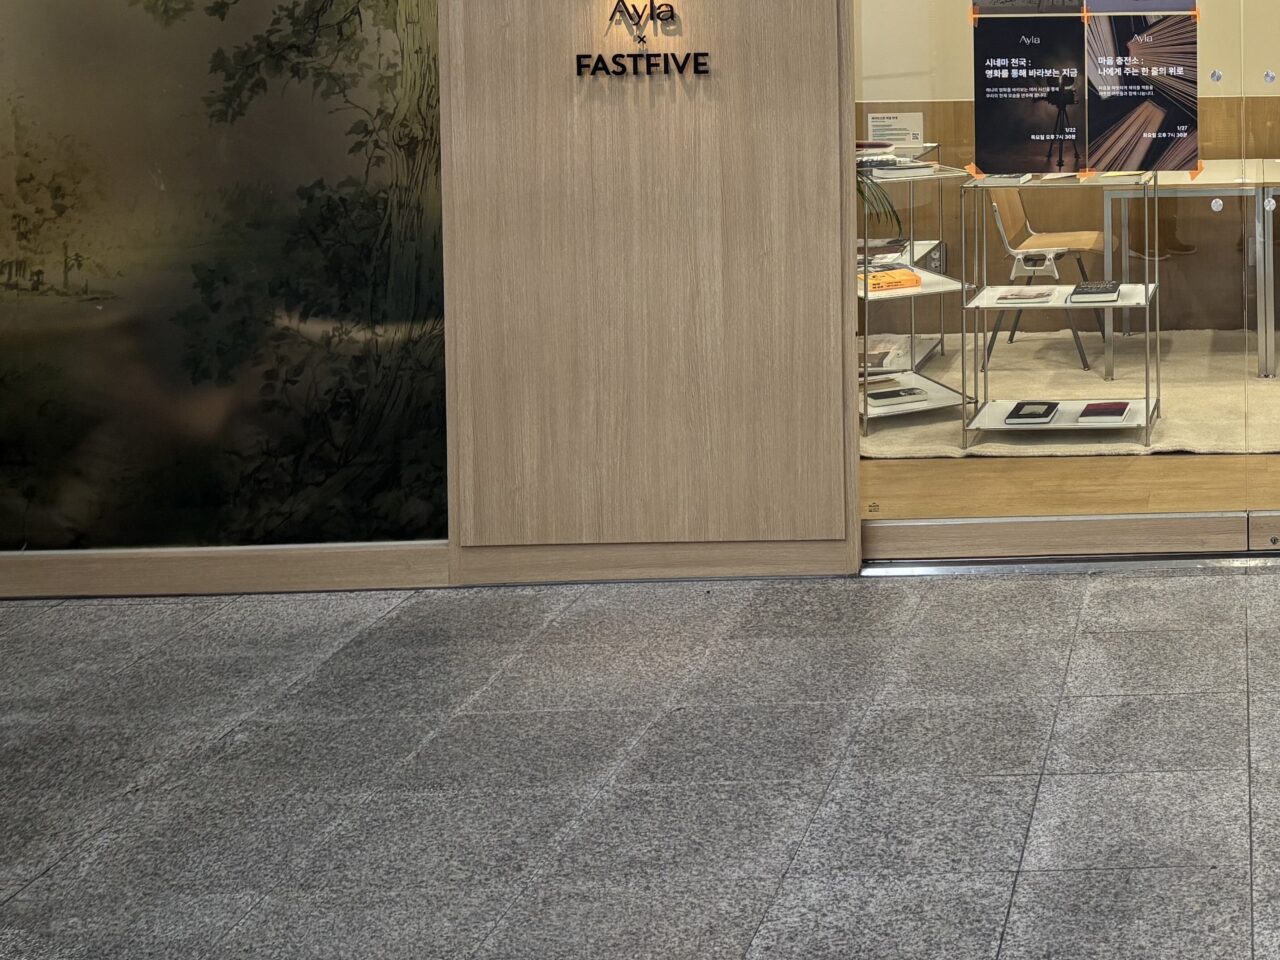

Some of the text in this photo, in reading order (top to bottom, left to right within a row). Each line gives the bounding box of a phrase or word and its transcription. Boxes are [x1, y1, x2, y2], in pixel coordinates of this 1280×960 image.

[1019, 35, 1040, 45] Ayla
[1132, 34, 1153, 43] Ayla
[576, 52, 709, 76] FASTFIVE
[985, 58, 1009, 67] 시네마
[1011, 58, 1026, 67] 천국
[1098, 57, 1113, 65] 마음
[1116, 56, 1139, 65] 충전소
[985, 68, 1078, 78] 영화를 통해 바라보는 지금
[1098, 66, 1184, 76] 나에게 주는 한 줄의 위로
